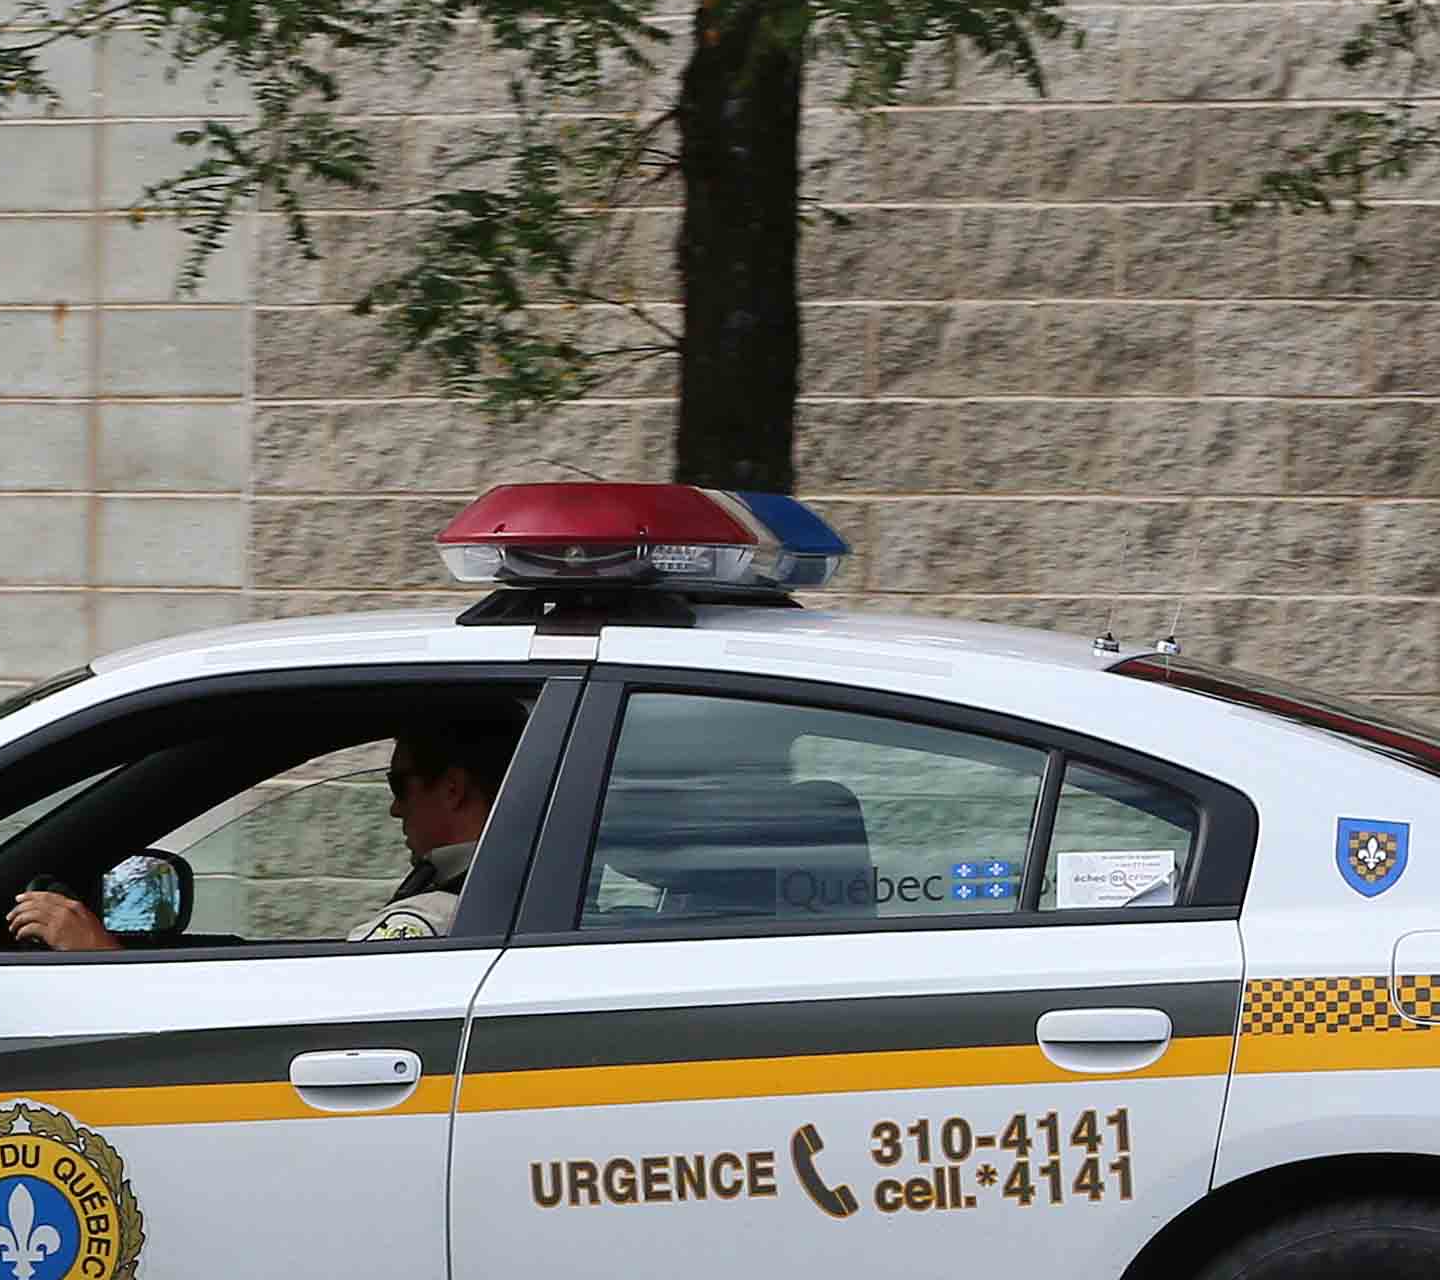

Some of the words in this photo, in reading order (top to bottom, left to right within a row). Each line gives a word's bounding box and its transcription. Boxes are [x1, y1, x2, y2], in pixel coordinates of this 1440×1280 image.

[782, 866, 945, 912] Québec
[870, 1107, 1131, 1168] 310-4141
[529, 1150, 779, 1209] URGENCE
[0, 1143, 41, 1169] DU
[53, 1156, 112, 1279] QUÉBEC
